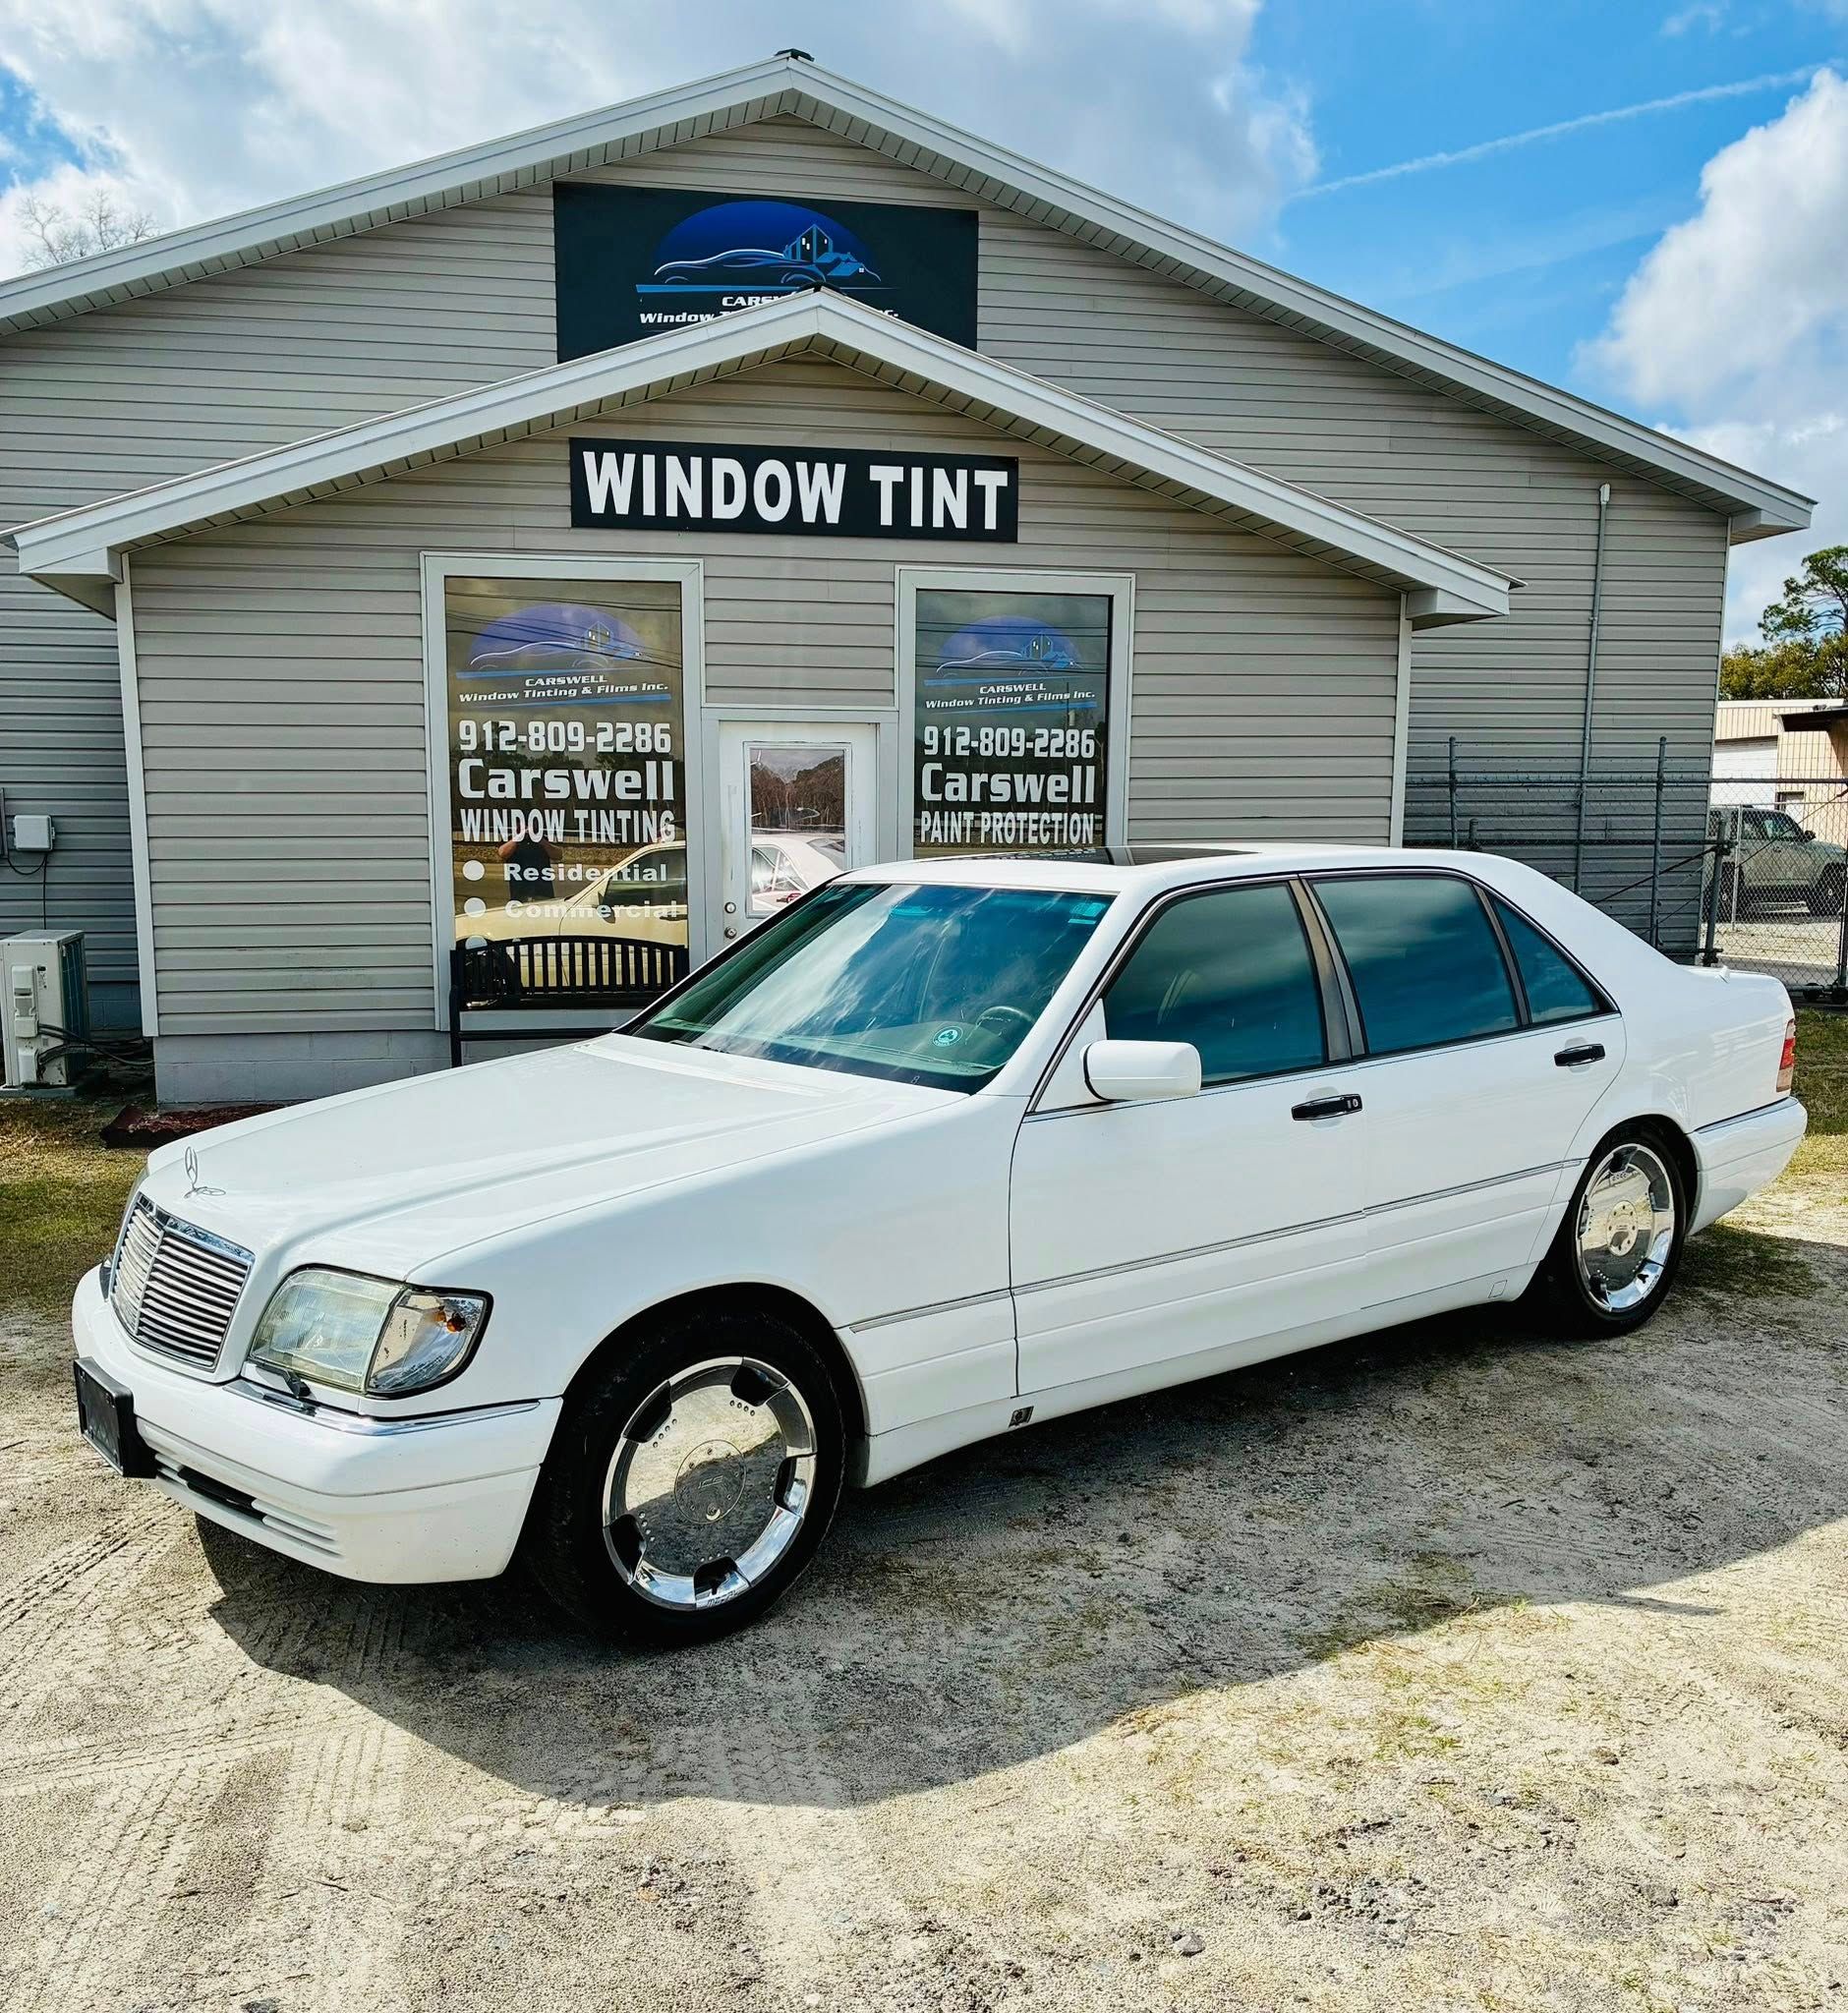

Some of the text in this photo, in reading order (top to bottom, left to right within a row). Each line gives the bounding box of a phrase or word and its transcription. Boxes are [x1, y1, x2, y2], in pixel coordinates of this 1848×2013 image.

[640, 312, 715, 323] Window
[583, 451, 1008, 530] WINDOW TINT
[459, 682, 668, 703] Window Tinting & Films Inc.
[525, 675, 607, 687] CARSWELL
[979, 683, 1046, 694] CARSWELL
[925, 690, 1095, 709] Window Tinting & Films Inc.
[458, 719, 671, 753] 912-809-2286
[923, 725, 1095, 758] 912-809-2286
[458, 758, 675, 801] Carswell
[921, 762, 1095, 803] Carswell
[460, 808, 676, 843] WINDOW TINTING
[920, 810, 1094, 844] PAINT PROTECTION
[503, 862, 667, 882] Residential
[504, 899, 678, 918] Commercial
